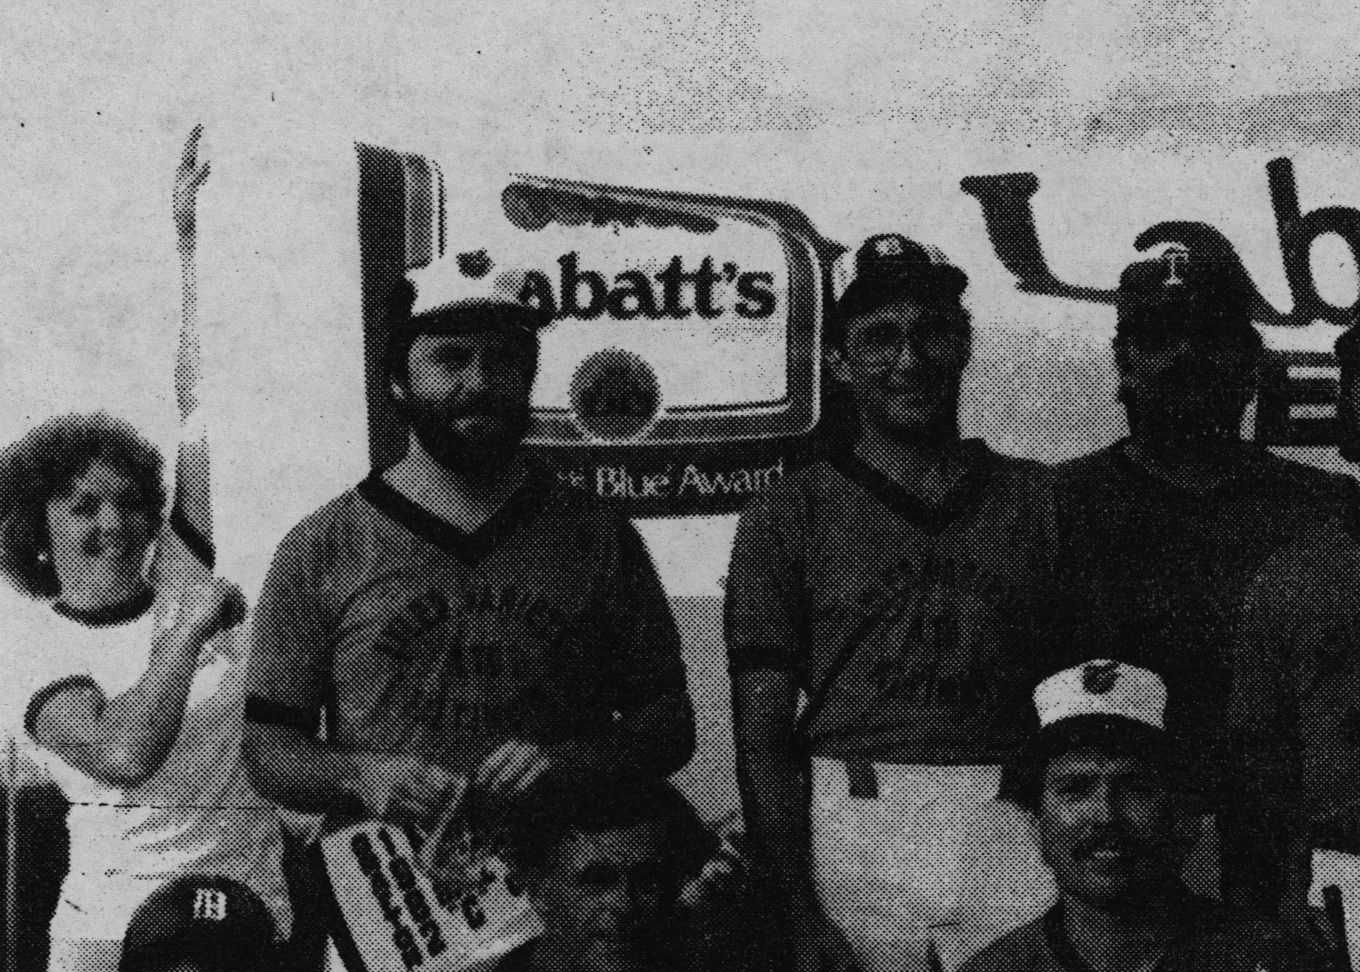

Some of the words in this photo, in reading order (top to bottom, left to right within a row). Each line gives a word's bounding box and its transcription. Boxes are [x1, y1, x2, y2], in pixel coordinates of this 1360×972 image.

[516, 250, 778, 321] abatt's
[597, 464, 672, 498] Blue
[677, 457, 784, 496] Award
